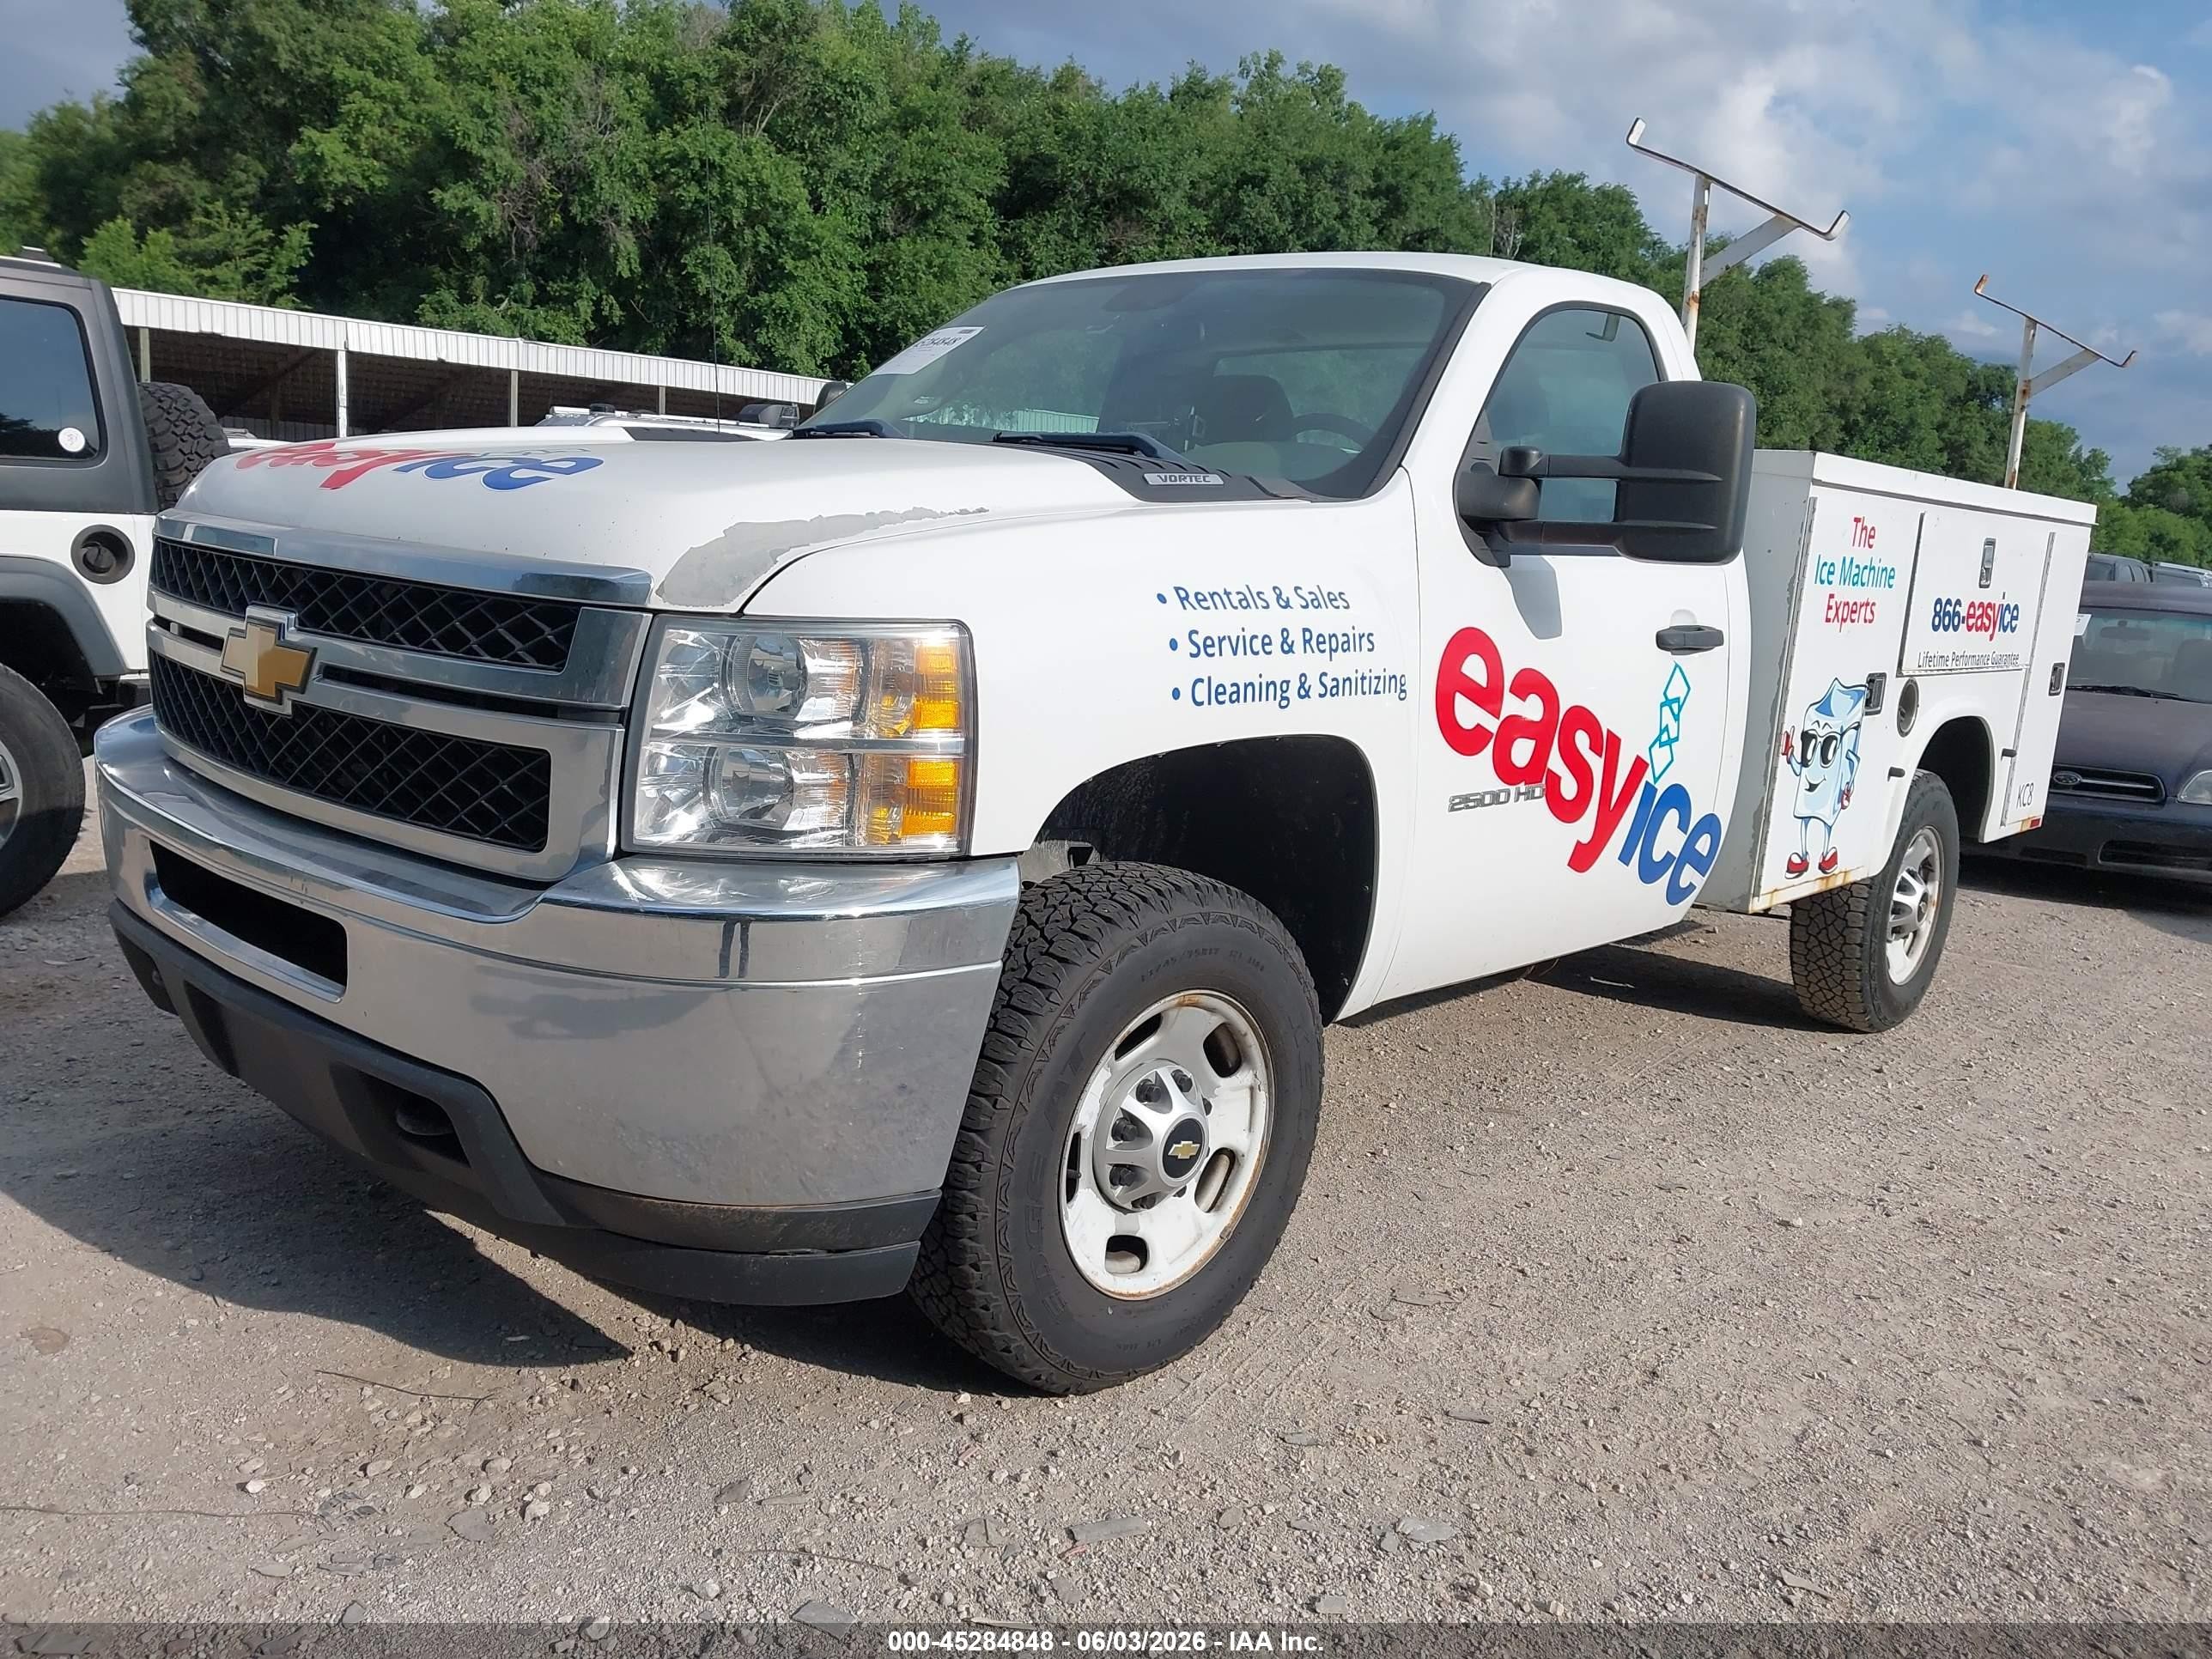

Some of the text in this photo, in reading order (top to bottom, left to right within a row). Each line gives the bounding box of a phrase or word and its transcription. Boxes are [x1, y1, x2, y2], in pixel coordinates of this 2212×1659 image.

[1851, 515, 1876, 550] The
[1814, 554, 1896, 589] Ice Machine
[1173, 584, 1351, 611] Rentals & Sales
[1825, 592, 1877, 634] Experts
[1188, 625, 1376, 662] Service & Repairs
[1917, 650, 2020, 668] Lifetime Performance Guarantee
[1191, 667, 1408, 709] Cleaning & Sanitizing
[1447, 784, 1546, 812] 2500 HD
[2015, 782, 2034, 809] KC8
